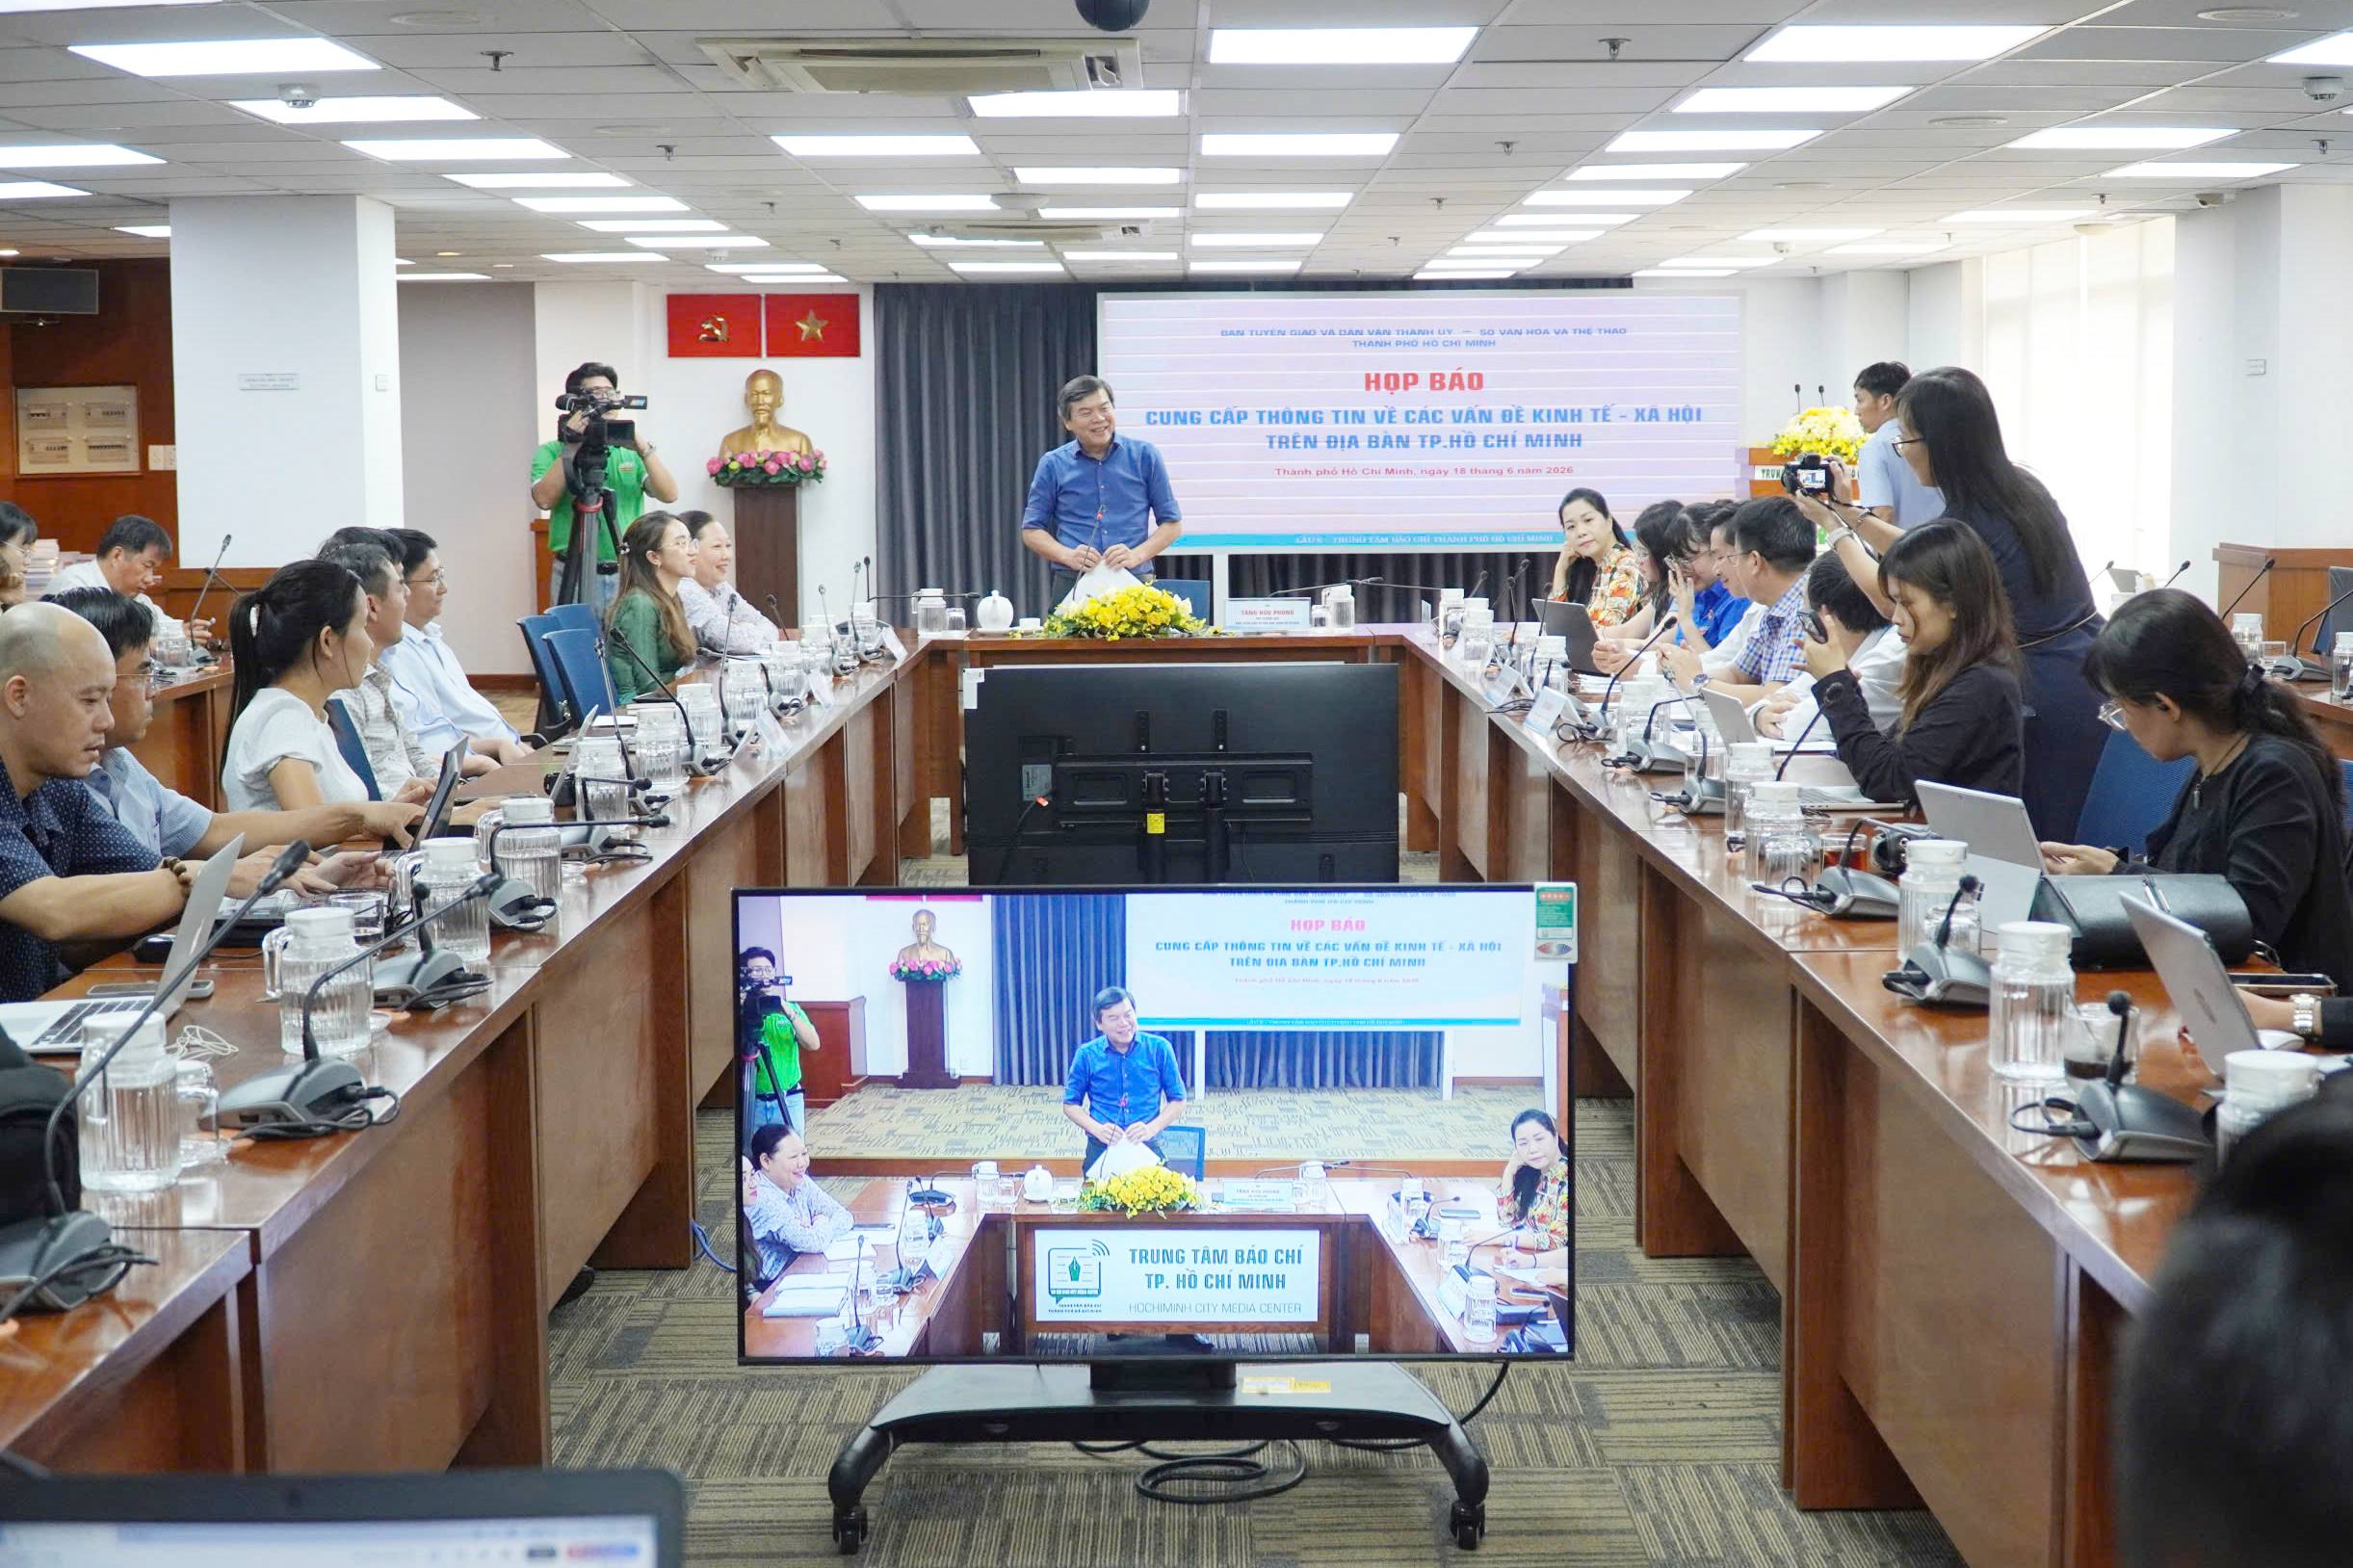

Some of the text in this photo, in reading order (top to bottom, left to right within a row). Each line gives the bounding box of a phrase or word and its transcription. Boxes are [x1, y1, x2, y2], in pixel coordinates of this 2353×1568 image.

[1364, 367, 1484, 395] HỌP BÁO
[1146, 410, 1202, 426] CUNG
[1210, 405, 1248, 425] CẤP
[1256, 406, 1323, 425] THÔNG
[1331, 410, 1366, 424] TIN
[1404, 405, 1444, 424] CÁC
[1451, 405, 1493, 424] VẤN
[1533, 408, 1583, 424] KINH
[1589, 403, 1616, 423] TẾ
[1668, 405, 1702, 424] HỘI
[1266, 431, 1318, 449] TRÊN
[1325, 434, 1360, 452] ĐỊA
[1368, 431, 1410, 449] BÀN
[1483, 431, 1517, 449] CHÍ
[1525, 433, 1582, 448] MINH
[1506, 466, 1514, 475] 6
[1761, 468, 1784, 479] TRUN
[1156, 942, 1190, 952] CUNG
[1271, 942, 1292, 952] TIN
[1395, 942, 1426, 952] KINH
[1389, 958, 1426, 967] MINH
[1129, 1244, 1304, 1265] TRUNG TÂM BÁO CHÍ
[1145, 1267, 1287, 1289] TP. HỒ CHÍ MINH
[1129, 1302, 1302, 1314] HOCHIMINH CITY MEDIA CENTER
